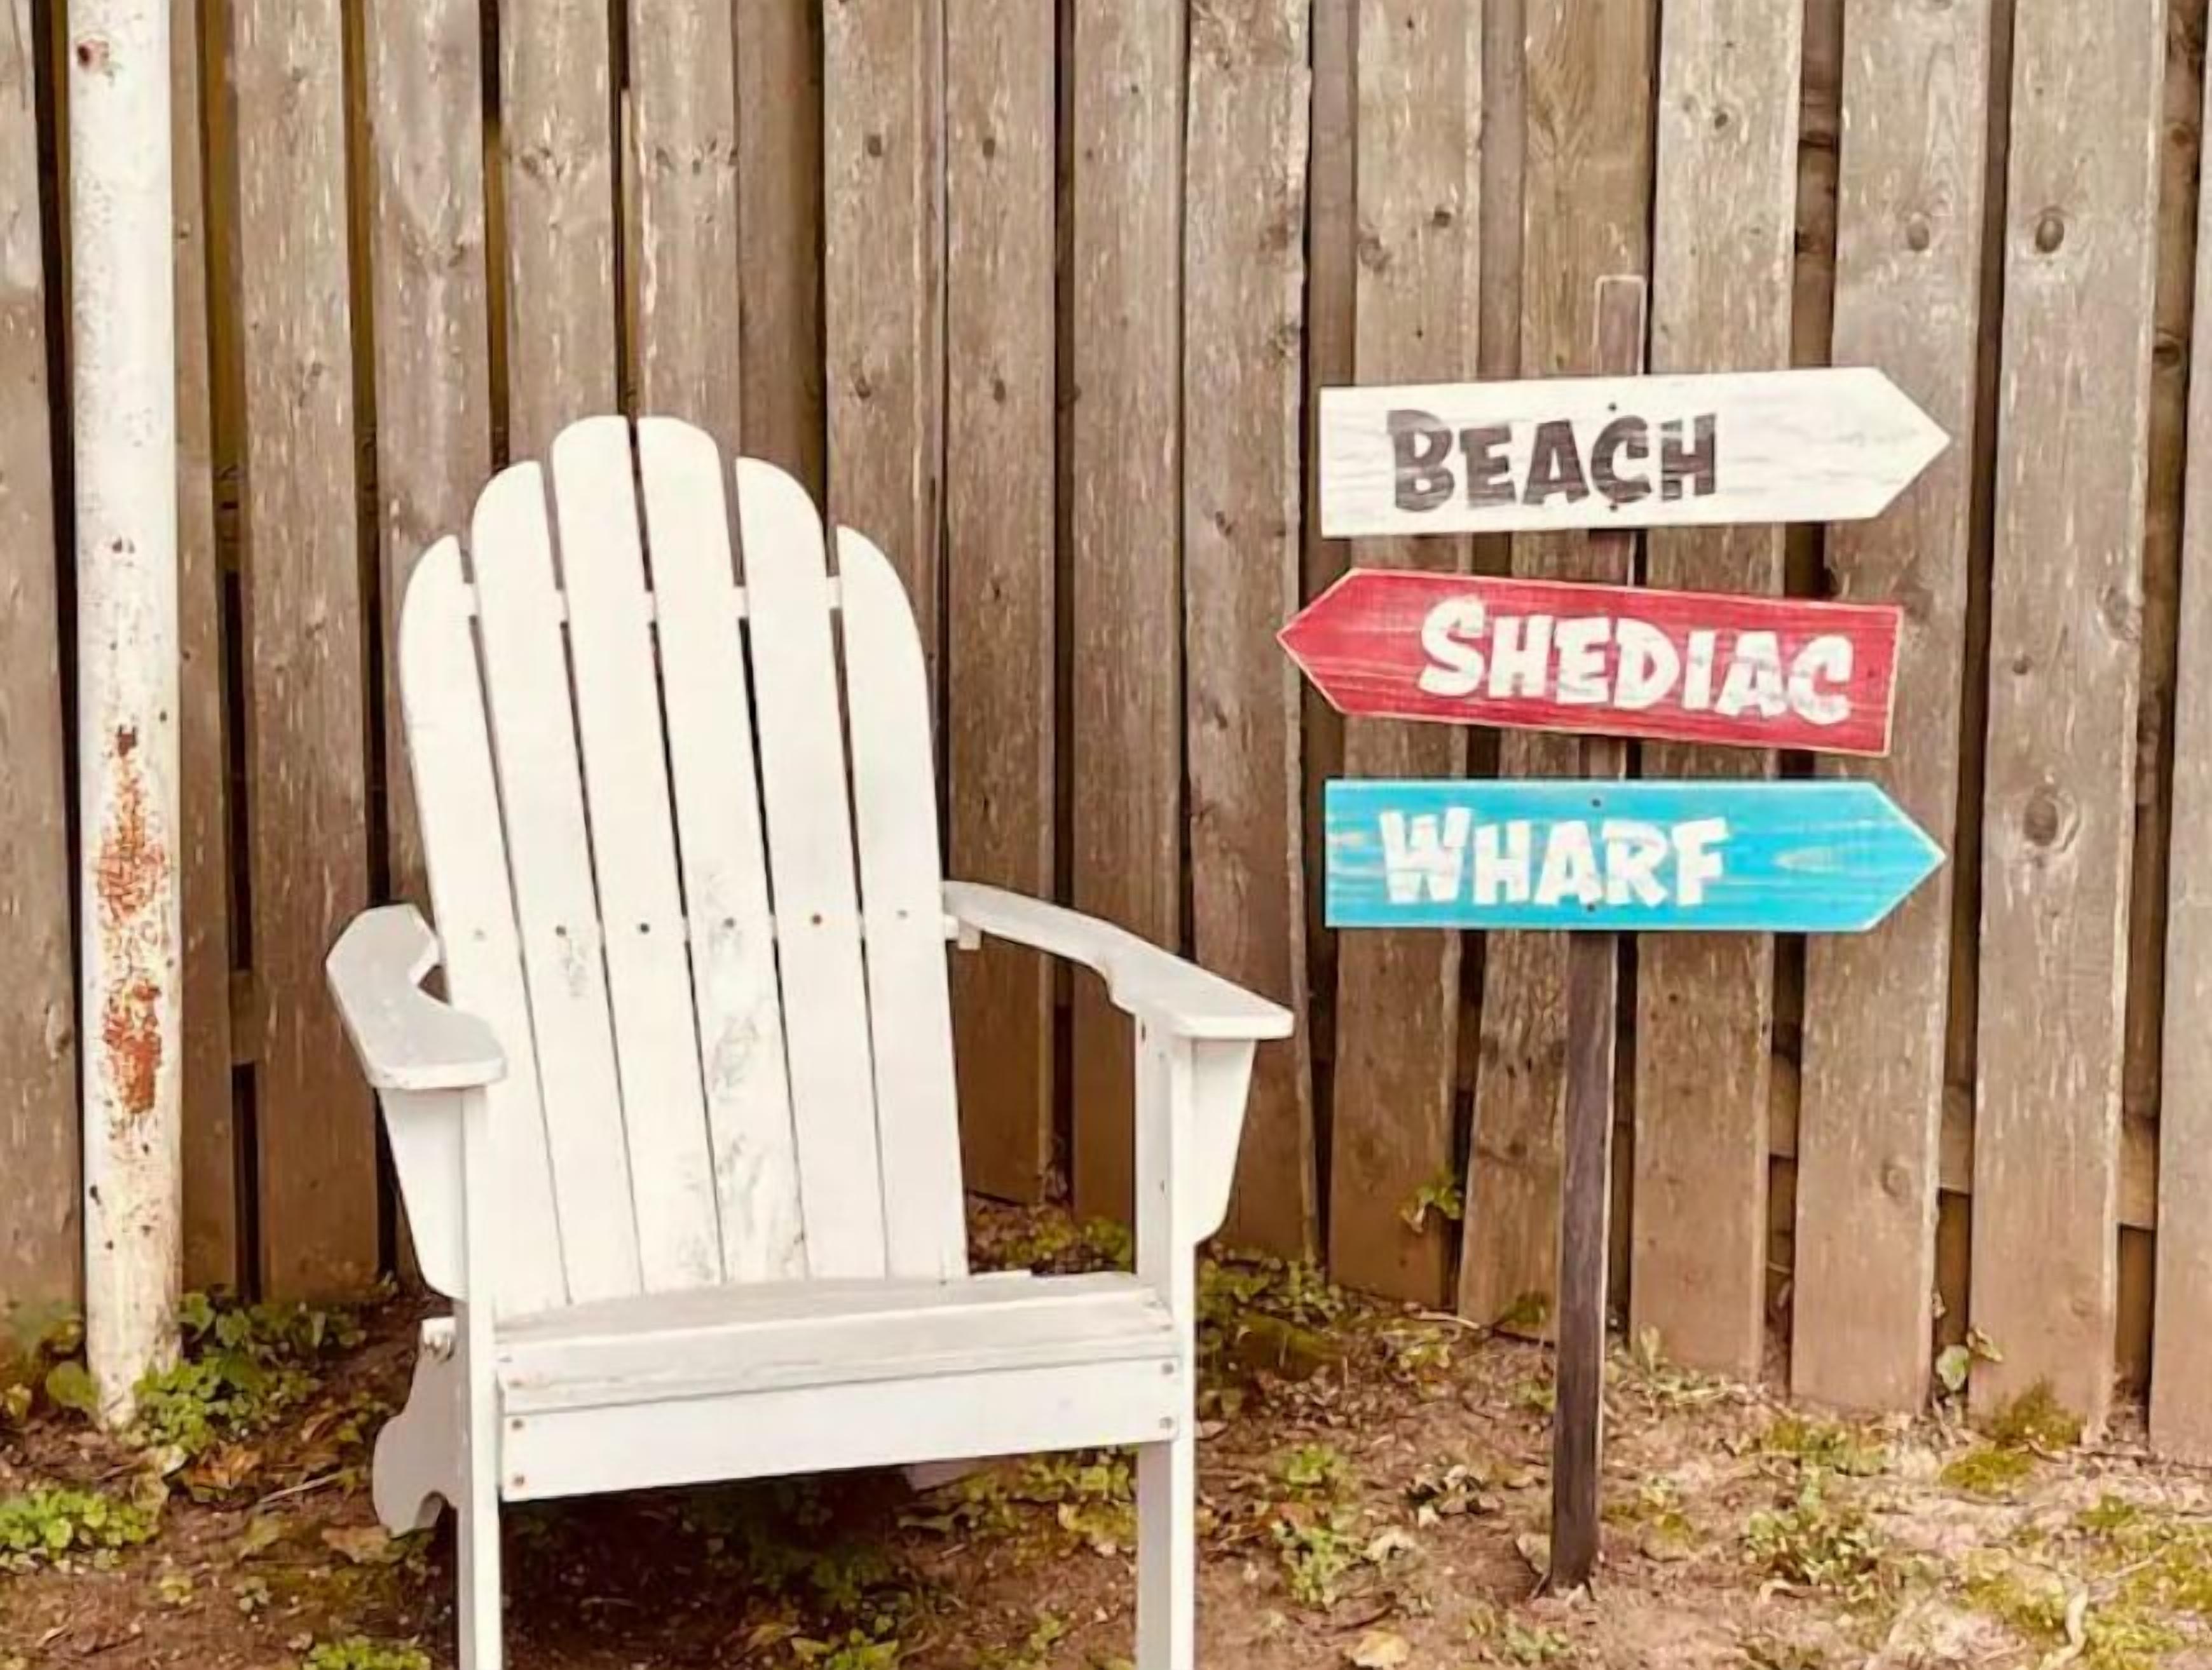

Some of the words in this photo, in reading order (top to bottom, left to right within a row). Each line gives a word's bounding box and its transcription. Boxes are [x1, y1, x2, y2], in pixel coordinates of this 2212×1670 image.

[1387, 409, 1717, 511] BEACH
[1417, 594, 1854, 724] SHEDIAC
[1379, 806, 1729, 907] WHARF
